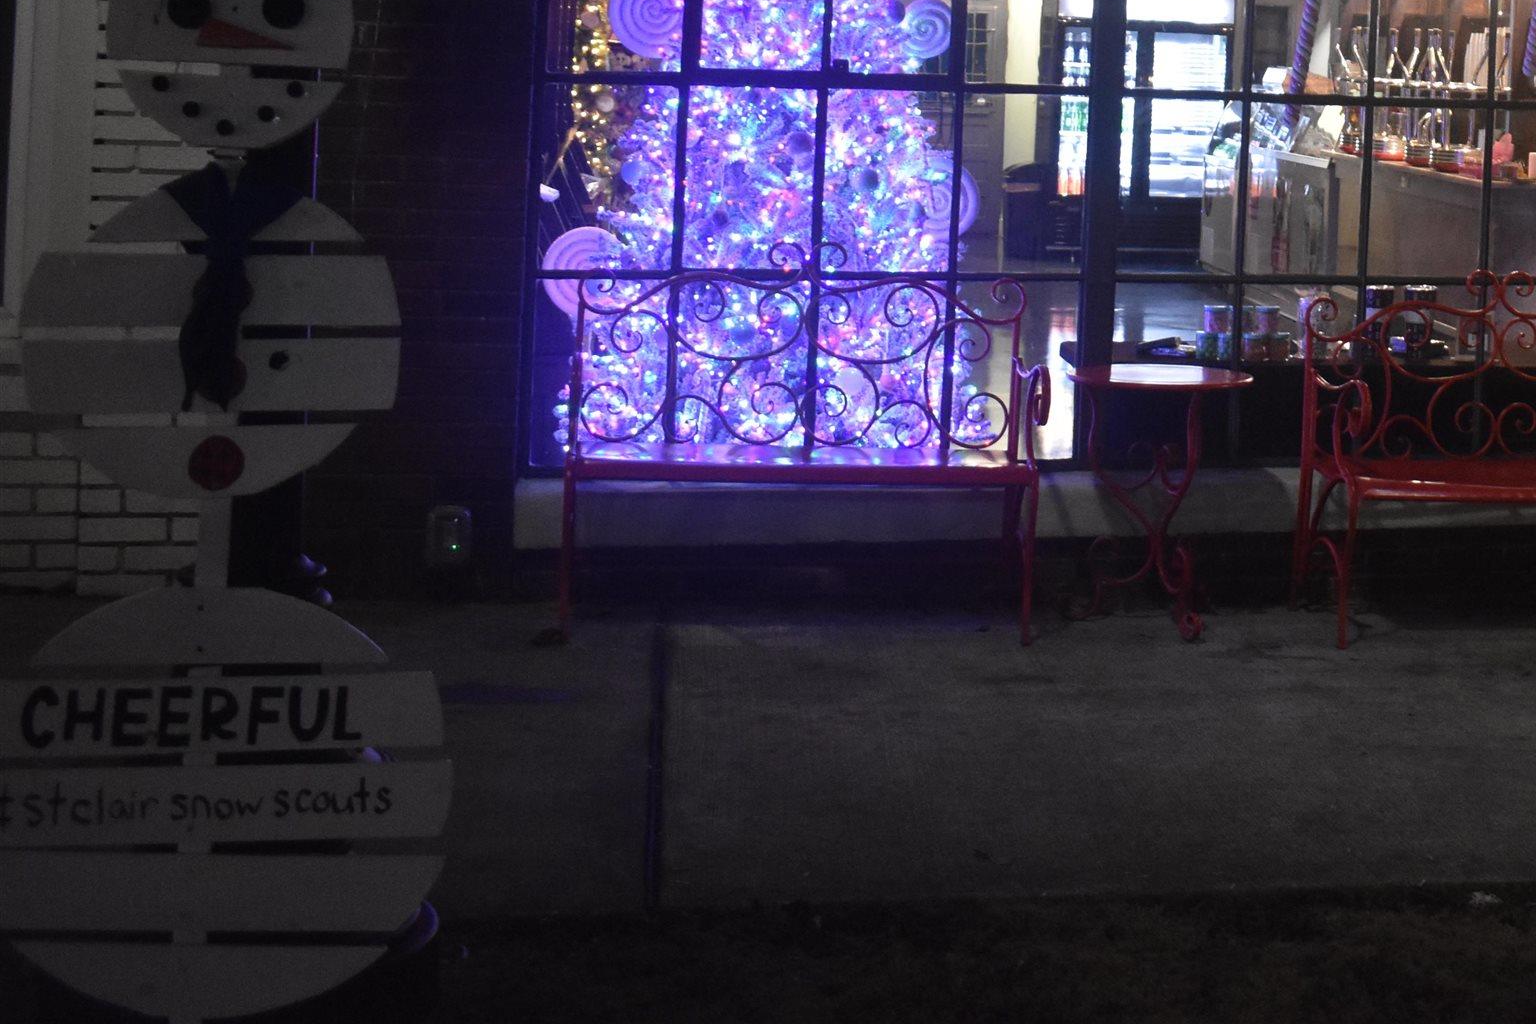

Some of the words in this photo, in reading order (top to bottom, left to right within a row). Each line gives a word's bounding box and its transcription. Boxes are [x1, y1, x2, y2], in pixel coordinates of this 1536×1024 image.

[20, 685, 362, 749] CHEERFUL
[170, 791, 265, 822] snow
[273, 776, 394, 819] scouts
